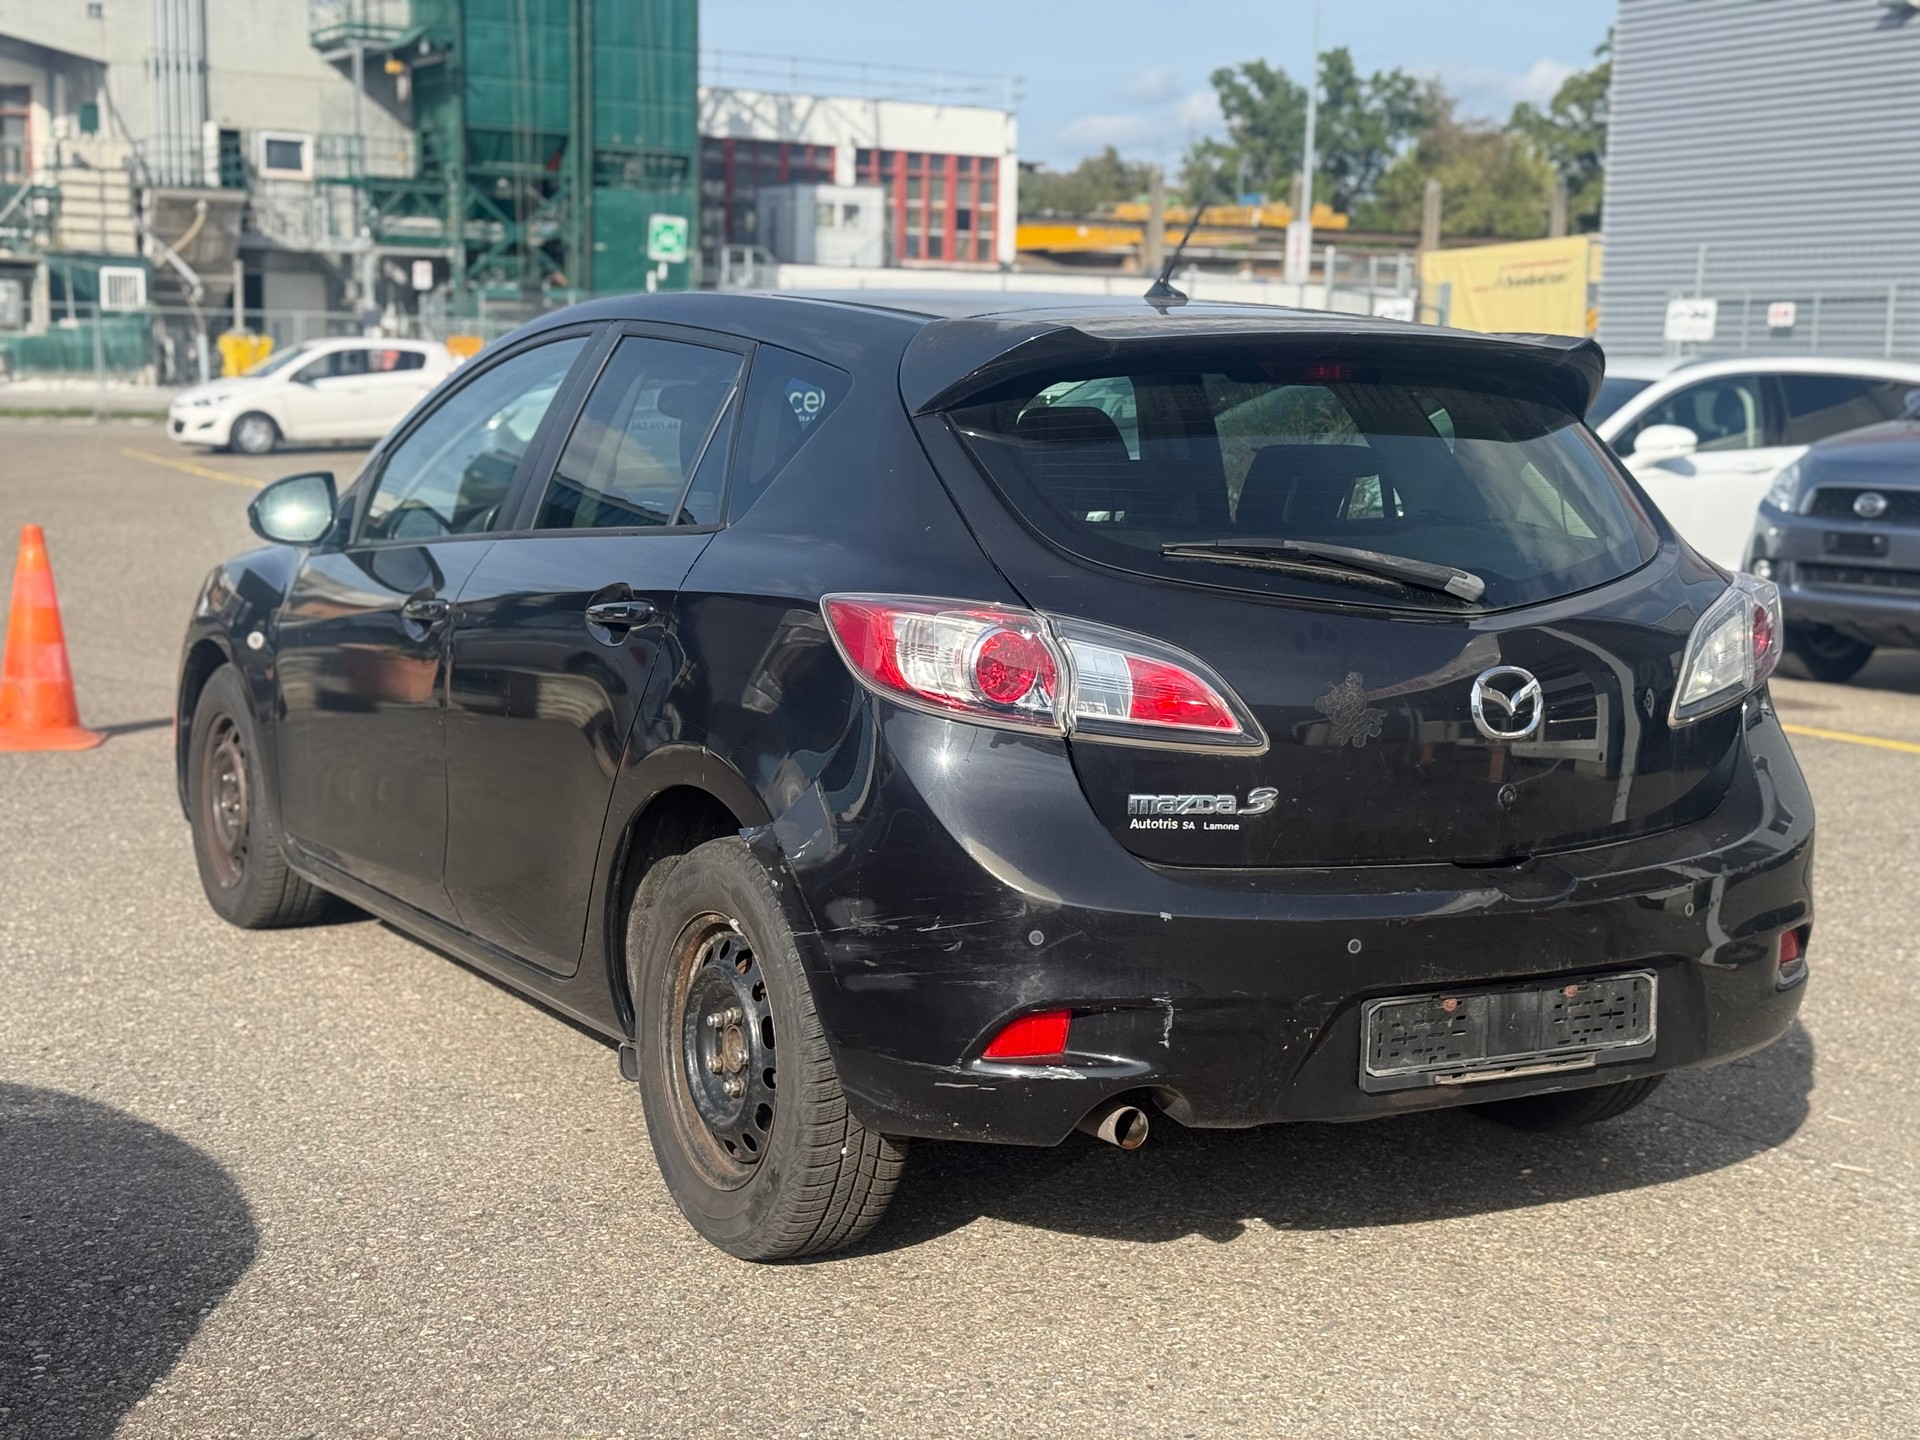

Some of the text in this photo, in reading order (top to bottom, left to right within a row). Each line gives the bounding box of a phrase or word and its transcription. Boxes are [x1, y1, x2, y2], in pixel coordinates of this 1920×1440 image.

[1237, 786, 1279, 815] 3
[1129, 818, 1240, 831] Autotris SA Lamone
